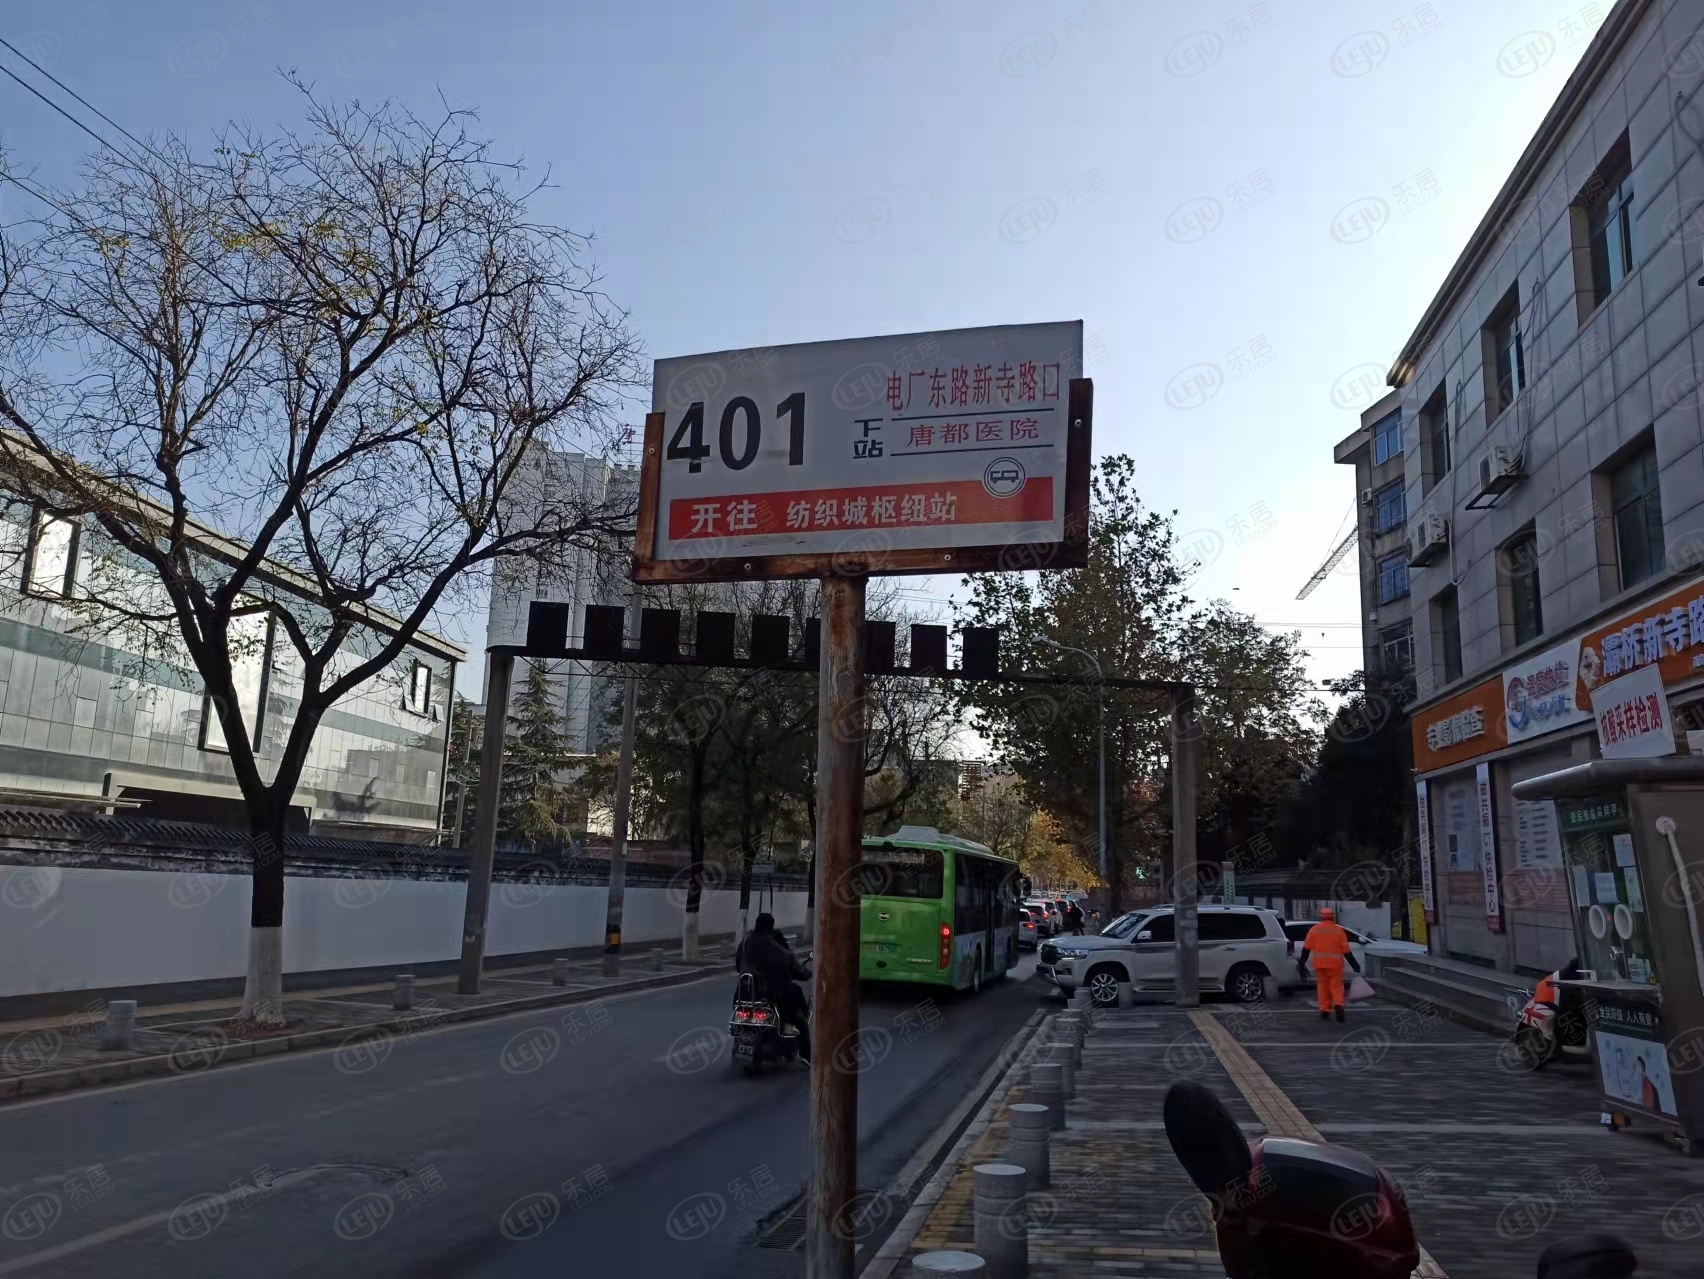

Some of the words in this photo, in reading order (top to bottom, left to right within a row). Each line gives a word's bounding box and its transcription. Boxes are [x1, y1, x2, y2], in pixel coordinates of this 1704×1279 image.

[886, 360, 1061, 412] 电厂东路新寺路口
[666, 391, 807, 475] 401
[906, 416, 1040, 448] 唐都医院
[689, 498, 759, 534] 开往
[785, 491, 958, 530] 纺织城枢纽站
